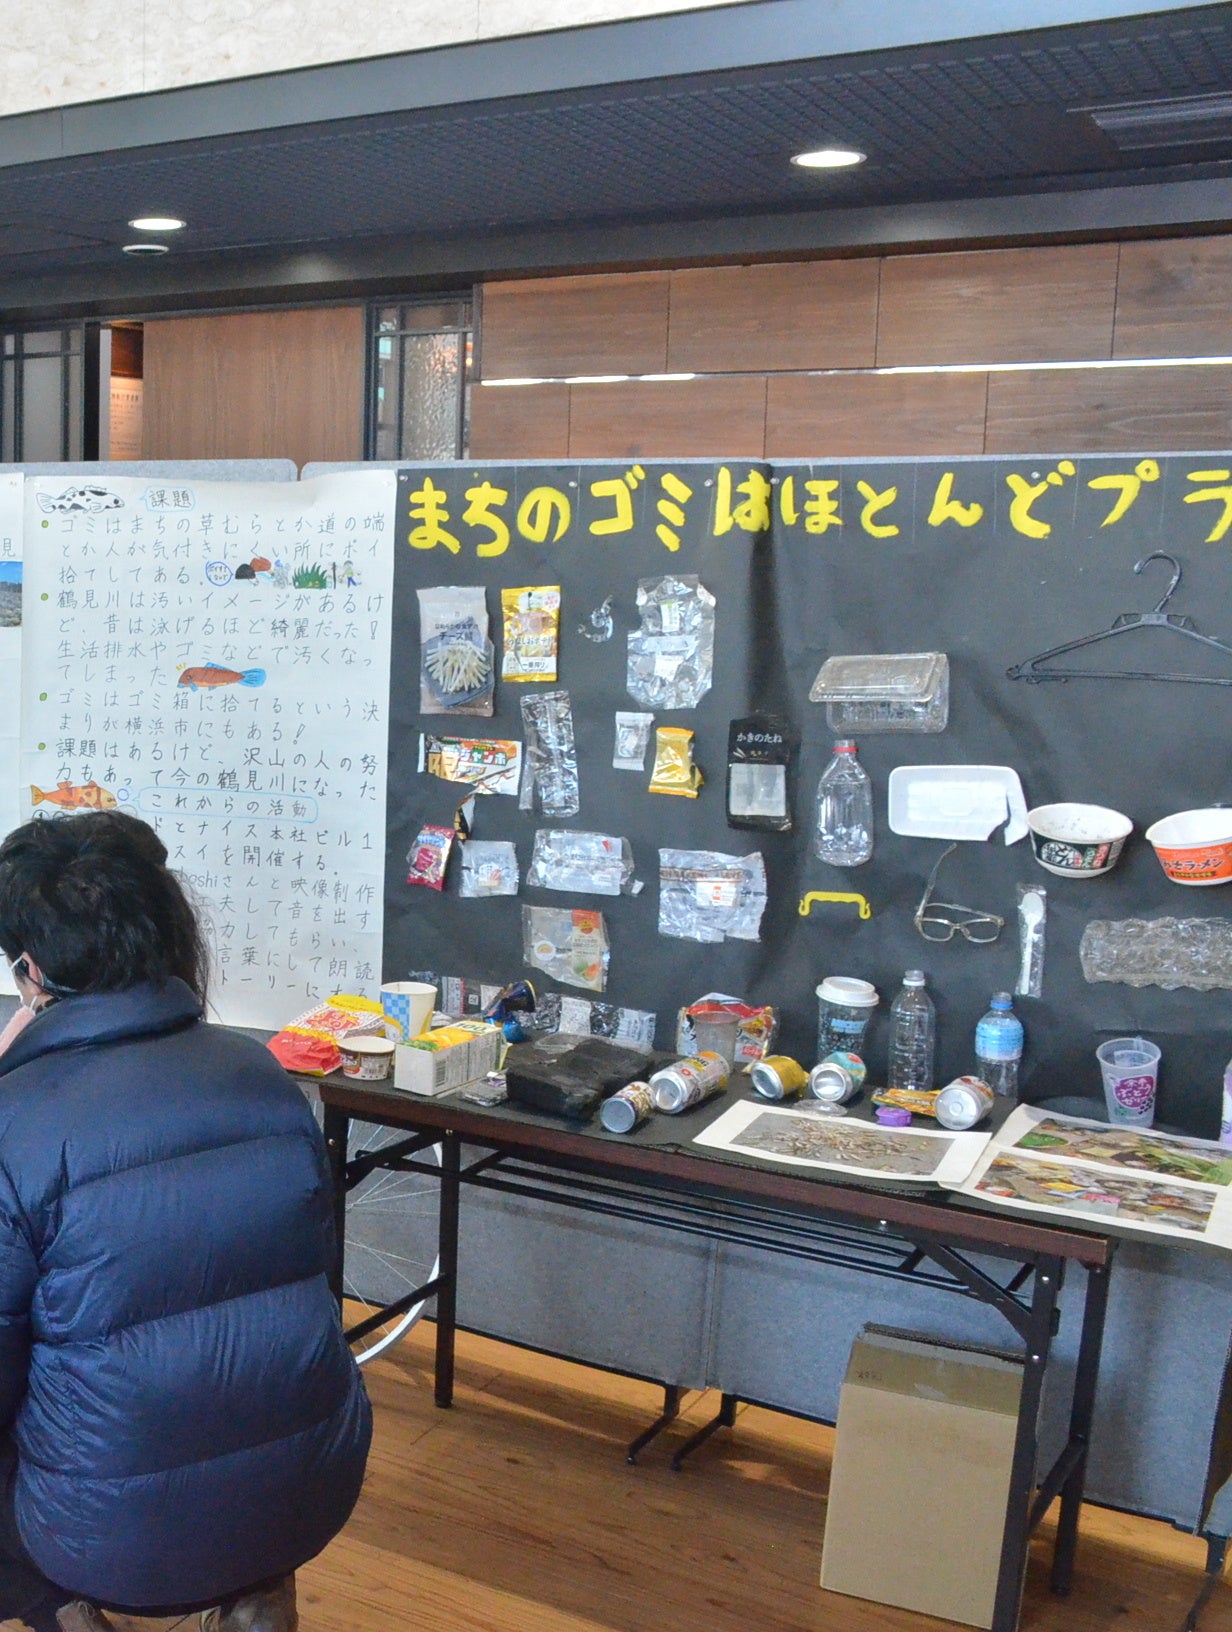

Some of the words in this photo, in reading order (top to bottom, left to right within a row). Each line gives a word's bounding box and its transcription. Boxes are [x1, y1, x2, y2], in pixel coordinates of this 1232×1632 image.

[149, 488, 193, 509] 課題
[408, 459, 1231, 558] まちのゴミはほとんどプラ
[736, 732, 783, 743] かきのたね
[151, 792, 308, 817] これからの活動
